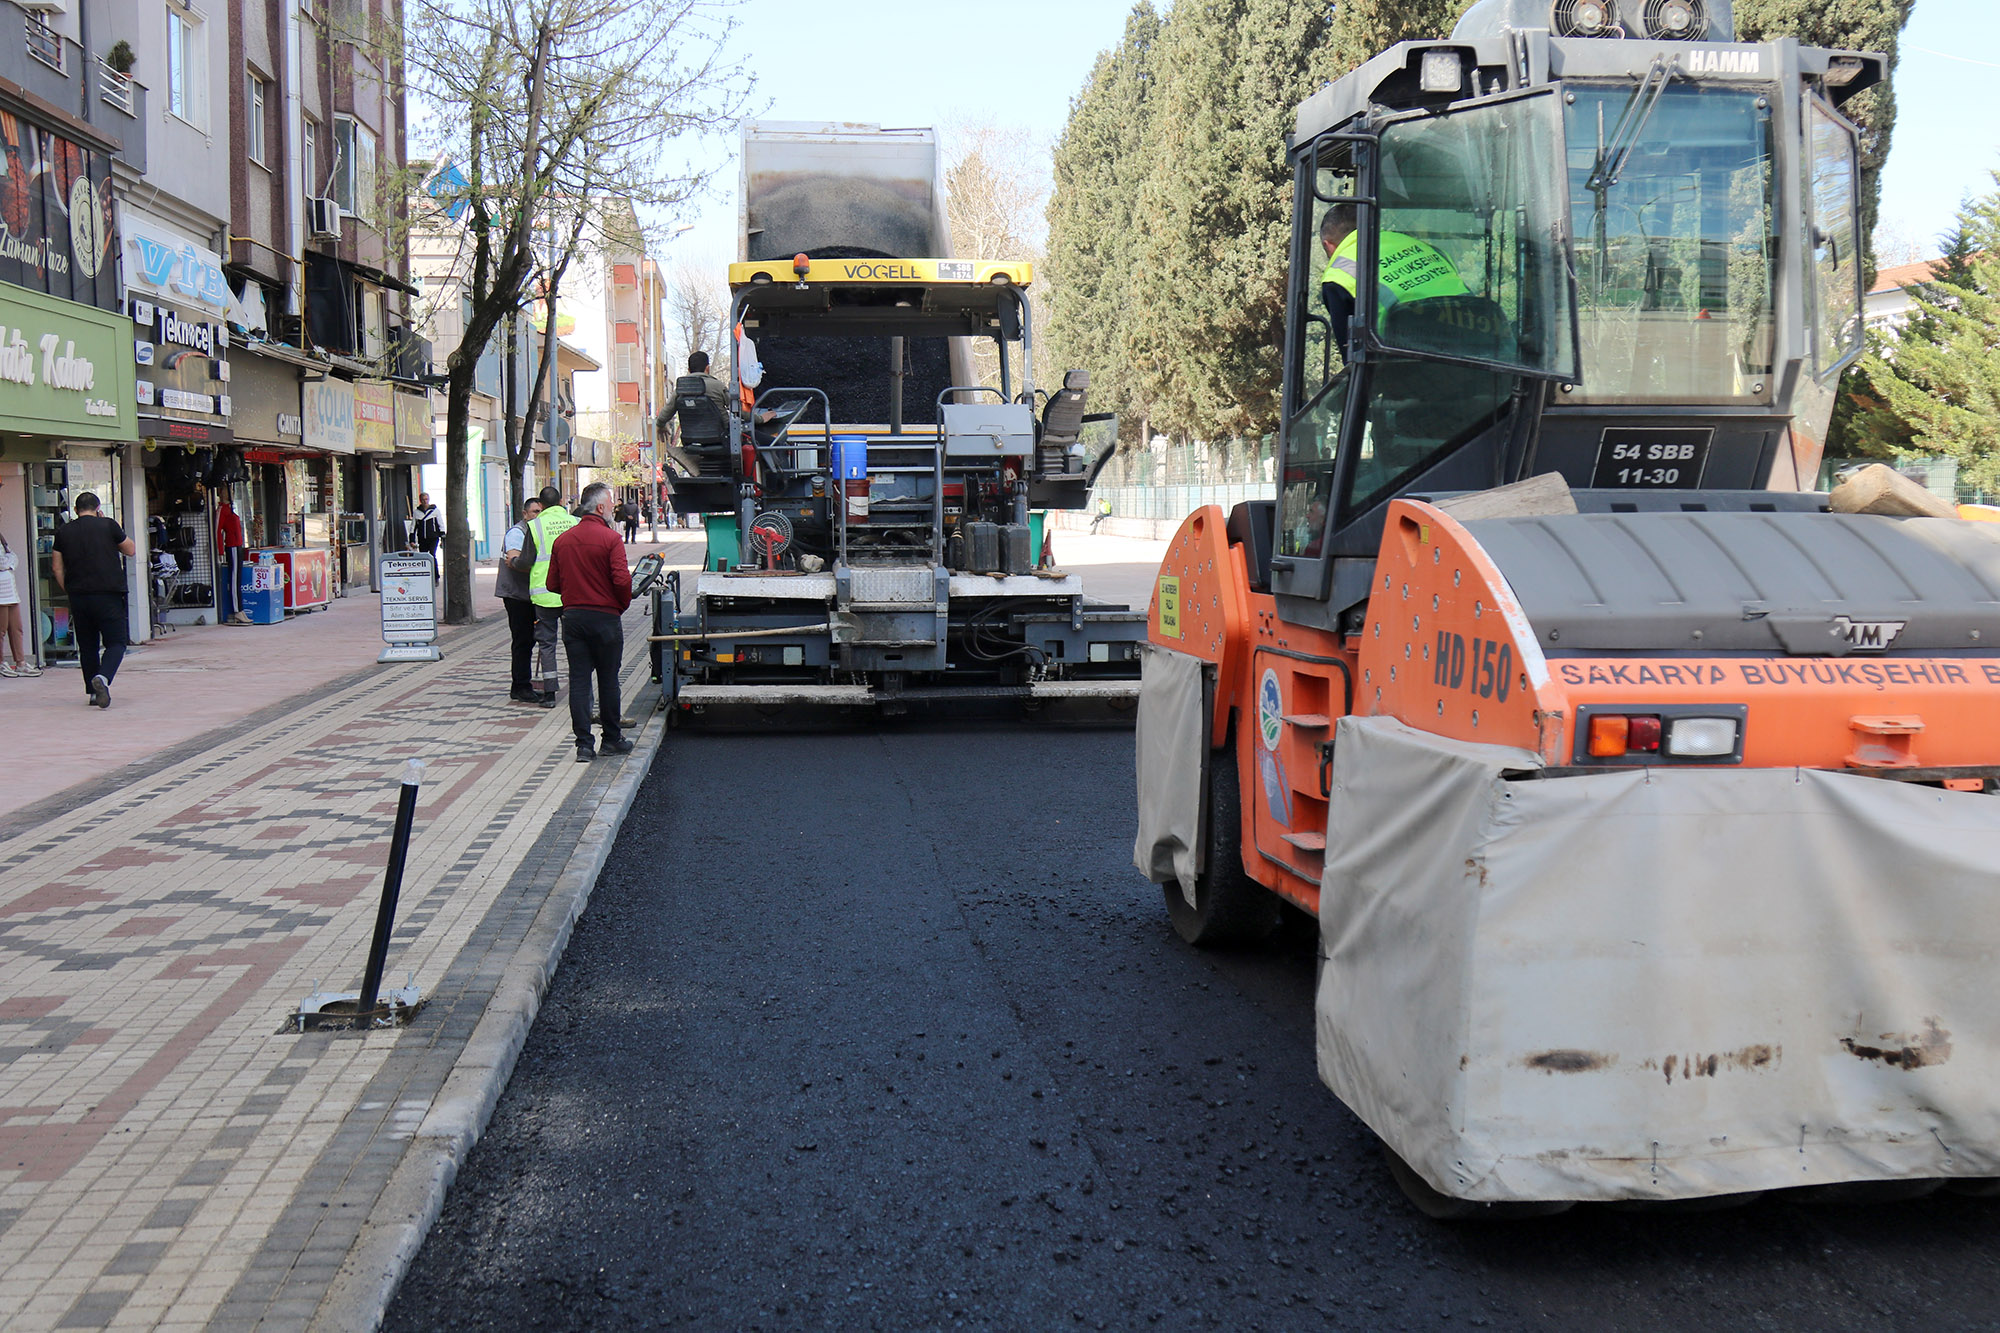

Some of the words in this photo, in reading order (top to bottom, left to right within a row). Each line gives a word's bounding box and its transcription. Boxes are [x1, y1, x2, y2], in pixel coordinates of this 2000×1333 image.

[1689, 50, 1760, 73] HAMM
[0, 223, 40, 267] Zaman
[40, 237, 69, 274] Taze
[1378, 245, 1424, 268] SAKARYA
[940, 263, 951, 271] 54
[158, 306, 214, 358] Teknocell
[40, 333, 95, 391] Kahve
[318, 384, 354, 436] ÇOLAK
[277, 413, 301, 437] ÇANTA
[1612, 444, 1641, 460] 54
[1647, 444, 1695, 460] SBB
[1617, 468, 1680, 484] 11-30
[255, 580, 262, 589] 3
[256, 572, 267, 580] SU
[1560, 664, 1727, 685] SAKARYA
[1739, 658, 1971, 691] BÜYÜKŞEHİR
